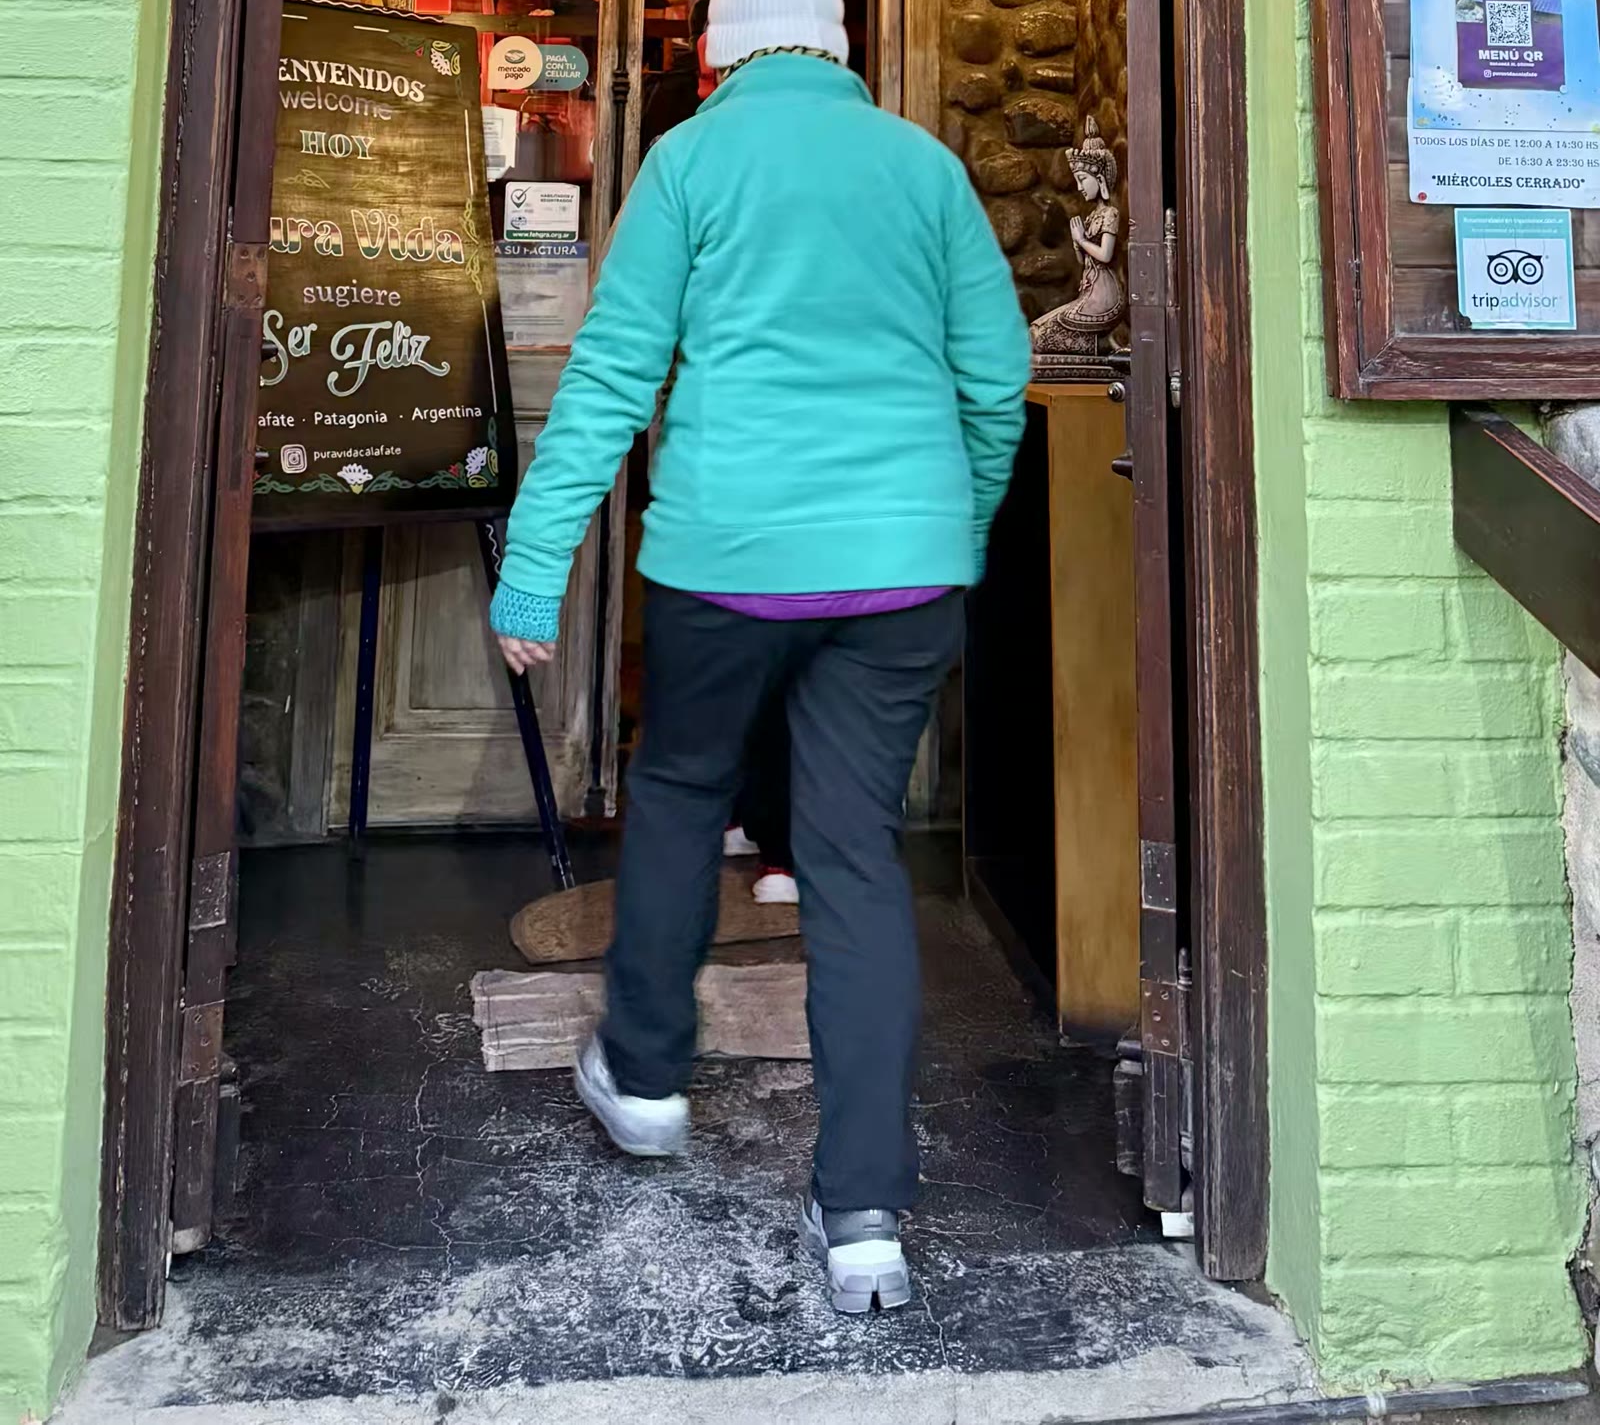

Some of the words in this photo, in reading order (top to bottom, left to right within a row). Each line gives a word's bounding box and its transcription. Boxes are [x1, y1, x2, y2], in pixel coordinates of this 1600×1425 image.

[1478, 48, 1519, 61] MENÚ
[1523, 50, 1543, 63] QR
[497, 65, 531, 73] mercado
[545, 62, 564, 70] CON
[565, 63, 576, 71] TU
[545, 70, 581, 79] CELULAR
[504, 72, 524, 80] pago
[279, 86, 392, 120] welcome
[299, 129, 376, 160] HOY
[1413, 136, 1447, 146] TODOS
[1448, 137, 1468, 146] LOS
[1470, 136, 1495, 147] DÍAS
[1497, 139, 1511, 148] DE
[1514, 139, 1542, 149] 12:00
[1544, 140, 1553, 149] A
[1555, 140, 1584, 150] 14:30
[1585, 141, 1599, 150] HS
[1498, 157, 1511, 166] DE
[1545, 158, 1553, 167] A
[1556, 158, 1584, 168] 23:30
[1586, 159, 1600, 168] HS
[351, 209, 465, 264] Vida
[504, 245, 520, 255] SU
[303, 280, 402, 307] sugiere
[1472, 293, 1559, 311] tripadvisor
[260, 309, 318, 386] Ser
[326, 320, 451, 397] Feliz
[314, 411, 388, 429] Patagonia
[411, 405, 482, 423] Argentina
[313, 445, 402, 462] puravidacalafate
